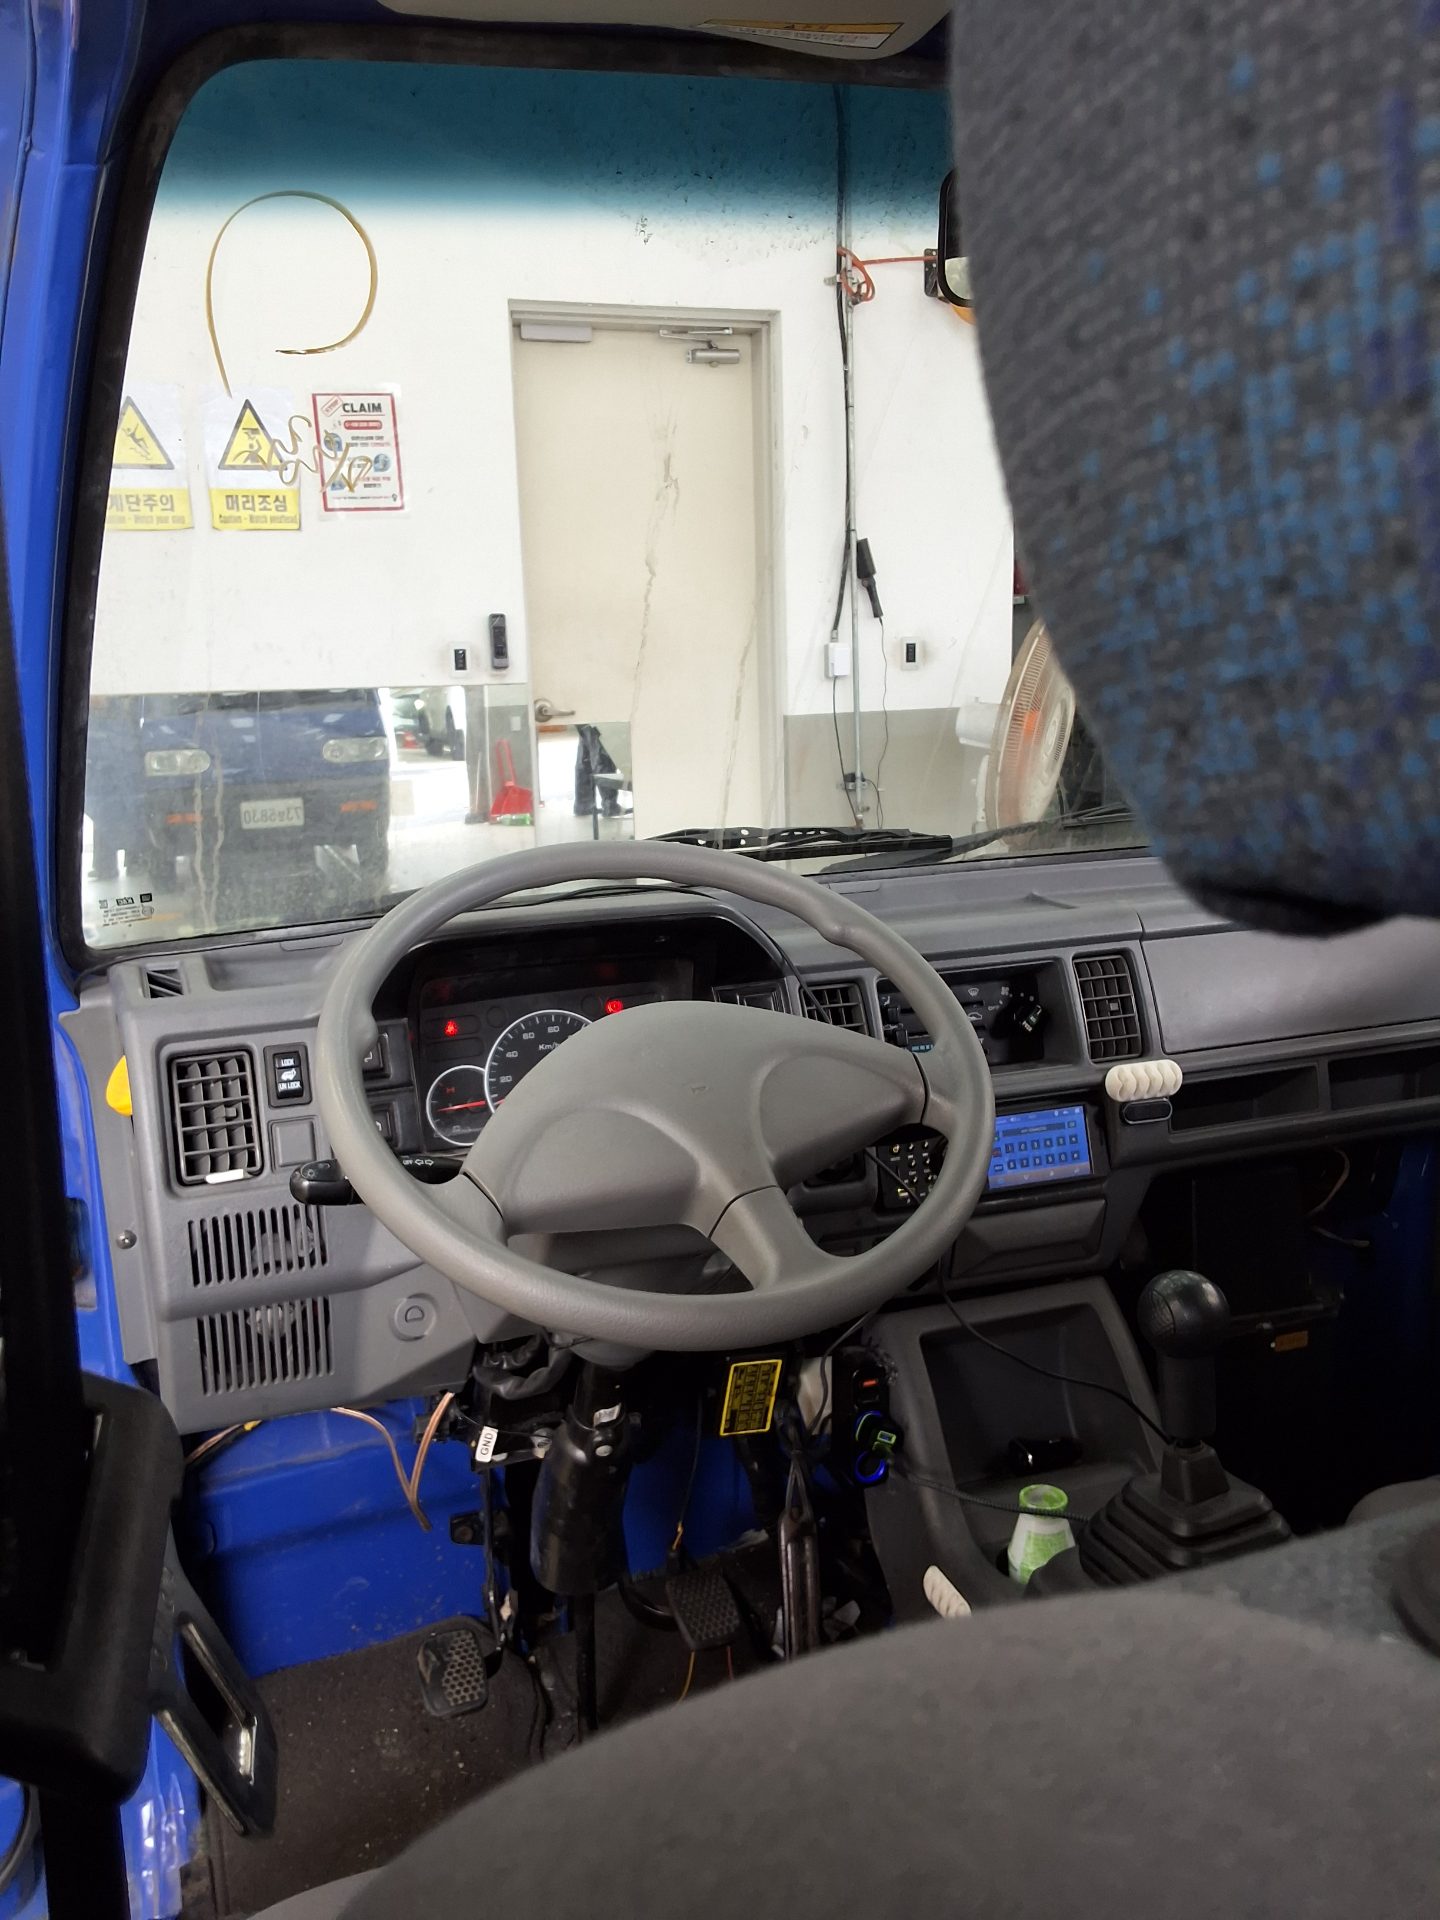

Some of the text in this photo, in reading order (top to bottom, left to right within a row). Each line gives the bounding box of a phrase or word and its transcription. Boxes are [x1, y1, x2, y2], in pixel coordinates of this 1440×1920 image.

[342, 402, 383, 413] CLAIM
[225, 494, 288, 513] 머리조심
[281, 1058, 294, 1066] LOCK
[480, 1432, 493, 1456] GND
